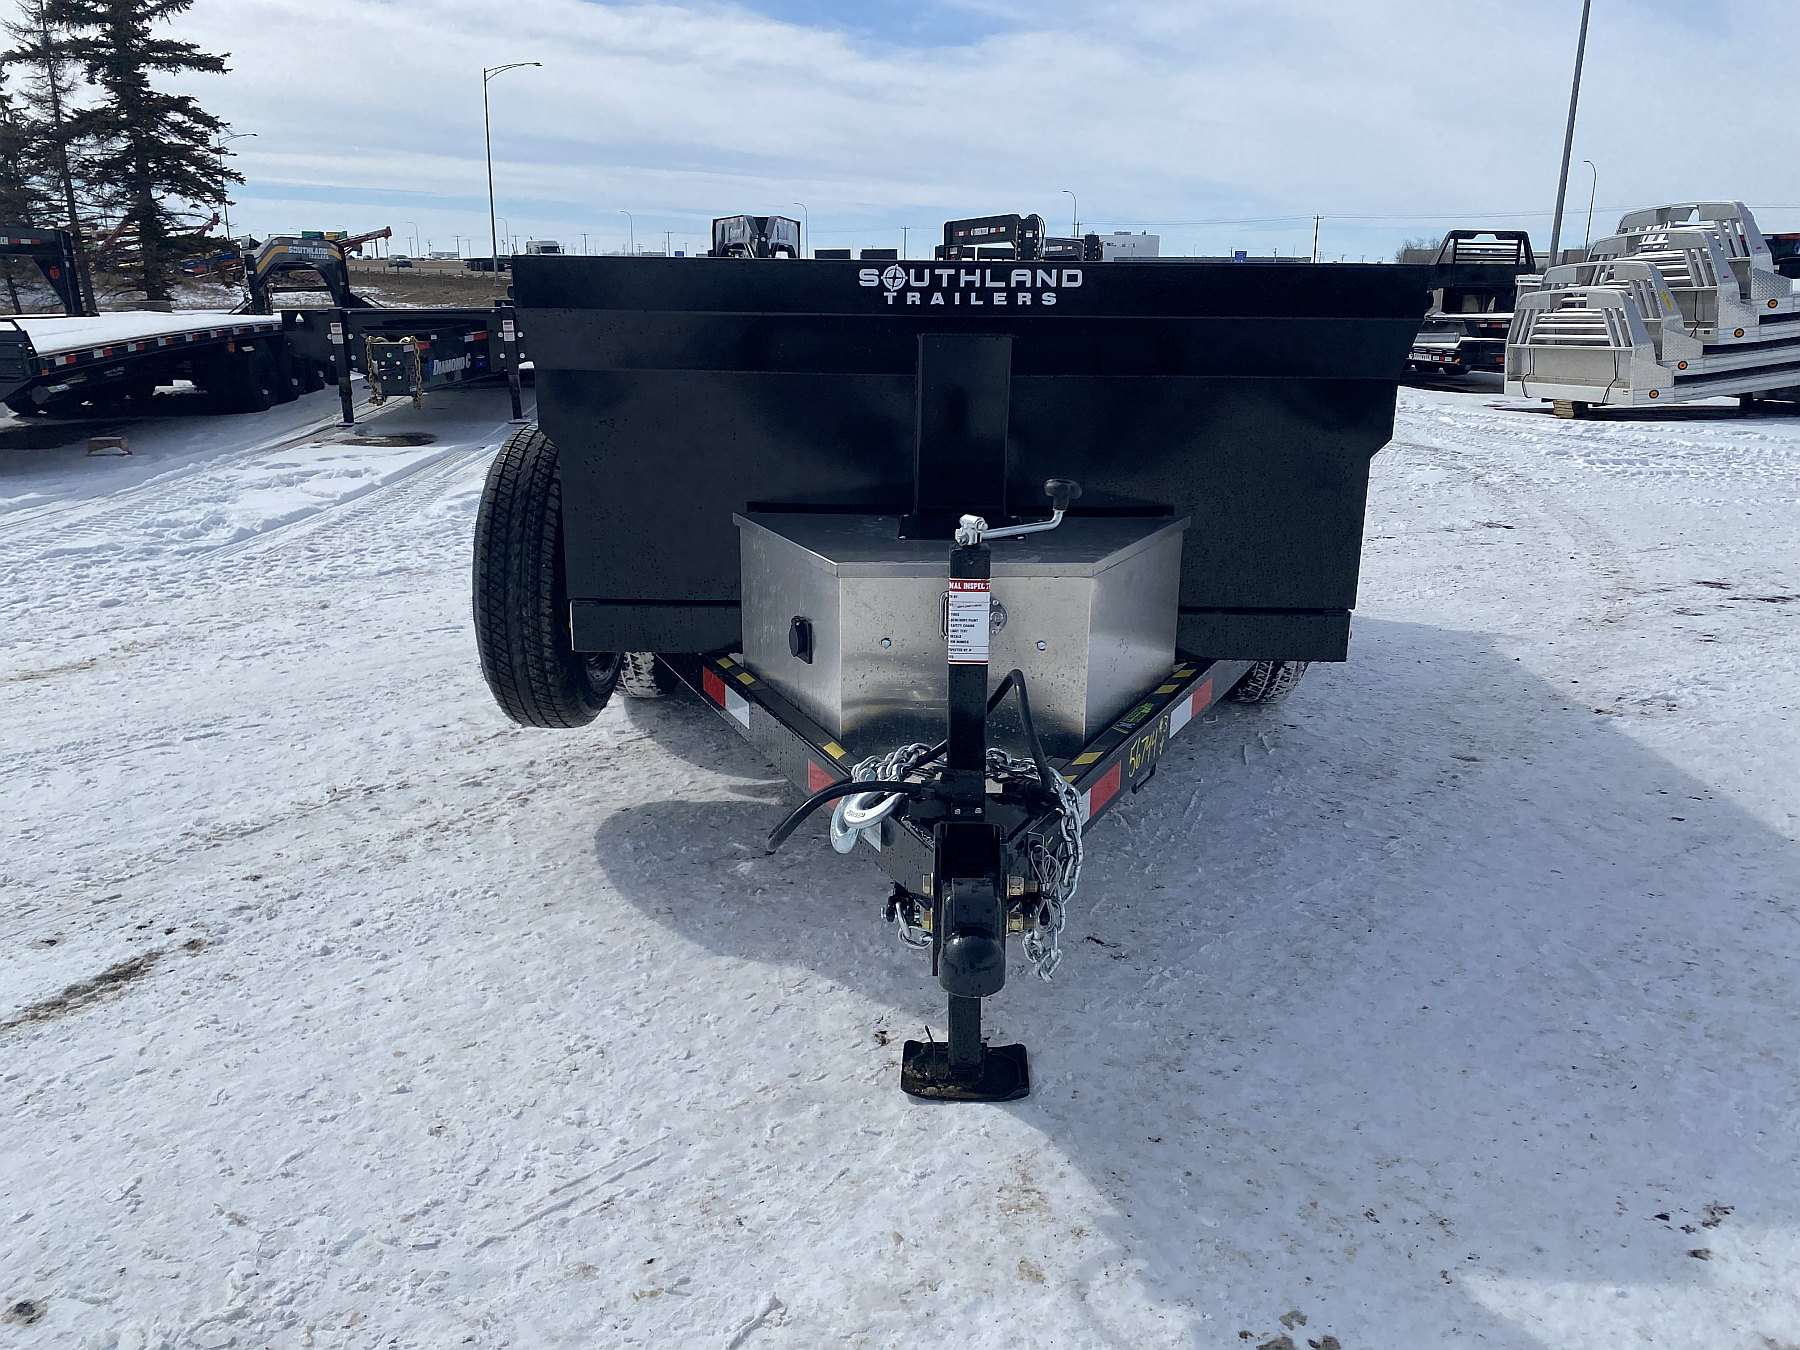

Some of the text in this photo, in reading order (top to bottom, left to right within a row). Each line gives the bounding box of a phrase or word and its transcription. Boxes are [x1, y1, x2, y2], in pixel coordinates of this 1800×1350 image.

[288, 246, 328, 254] SOUTHLAND
[859, 265, 1083, 291] SOUTHLAND
[884, 293, 1057, 305] TRAILERS
